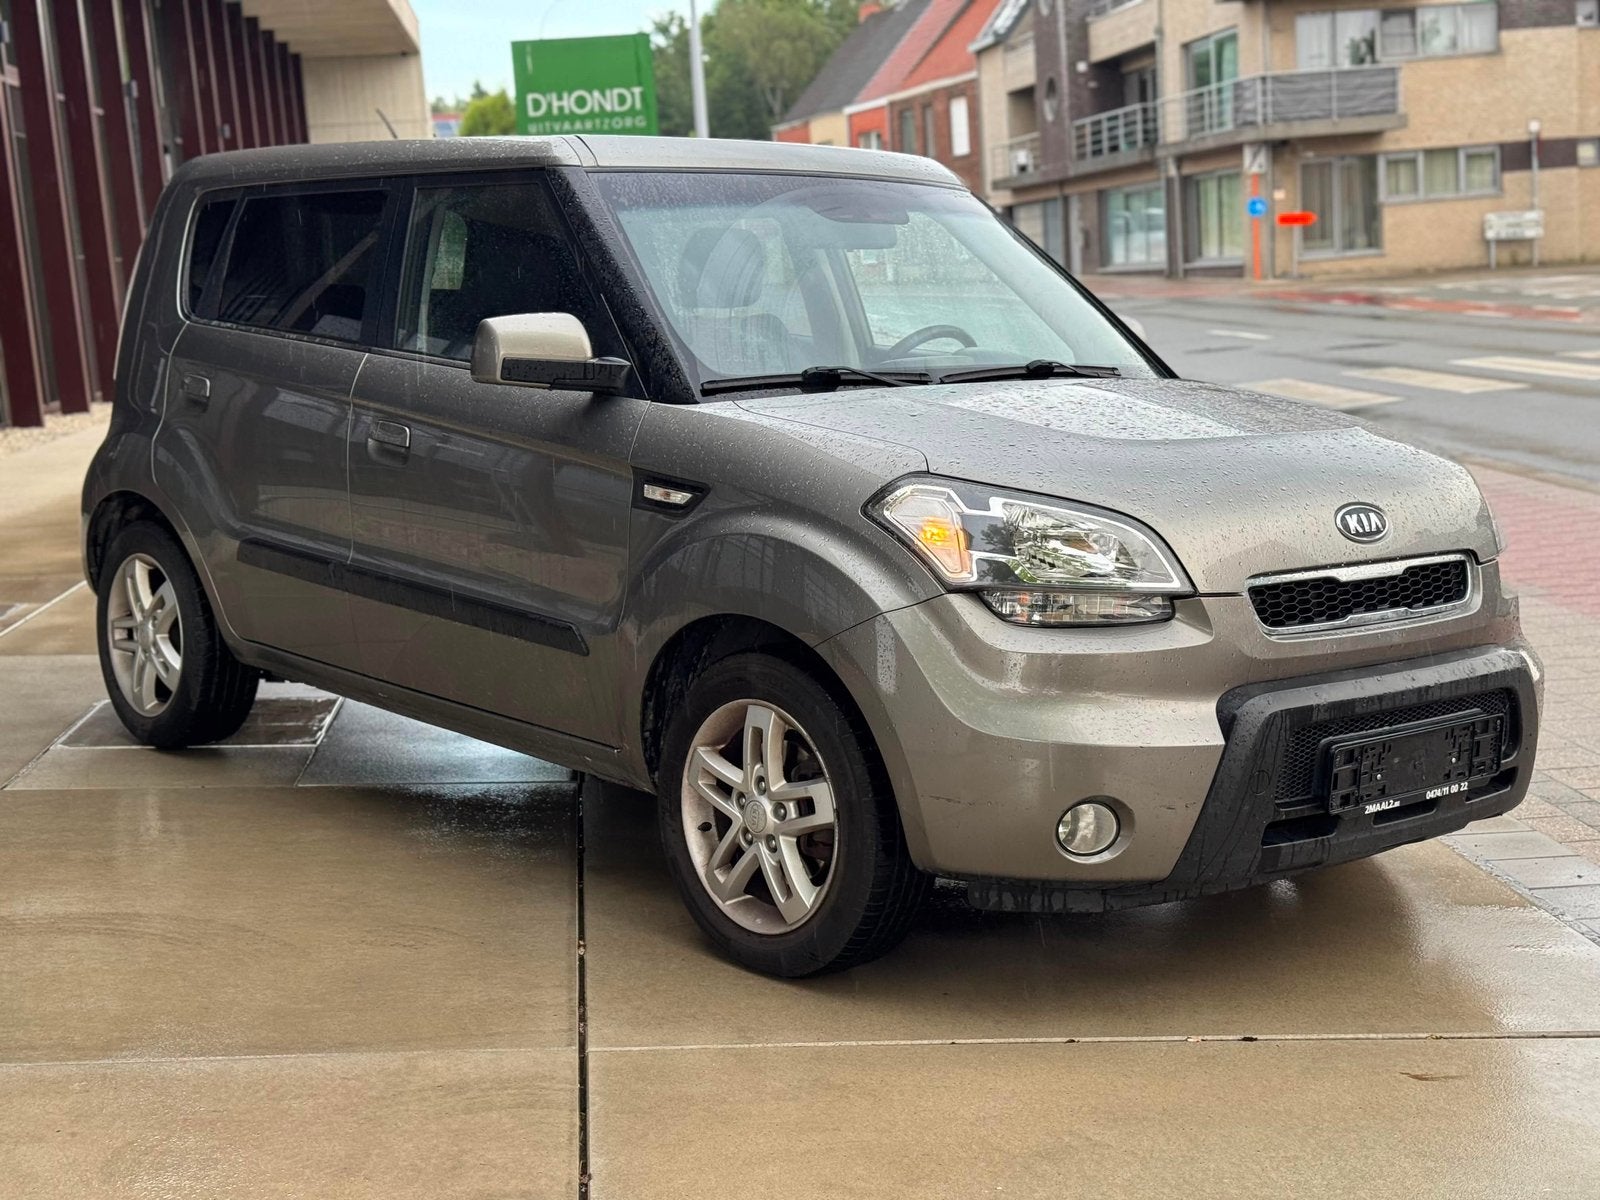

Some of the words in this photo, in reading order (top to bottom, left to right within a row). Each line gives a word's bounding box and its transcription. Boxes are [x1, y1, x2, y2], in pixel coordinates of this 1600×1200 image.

[526, 86, 643, 117] D'HONDT
[1345, 512, 1384, 534] KIA
[1426, 786, 1449, 799] 0474/11
[1450, 784, 1459, 794] 00
[1460, 781, 1469, 791] 22
